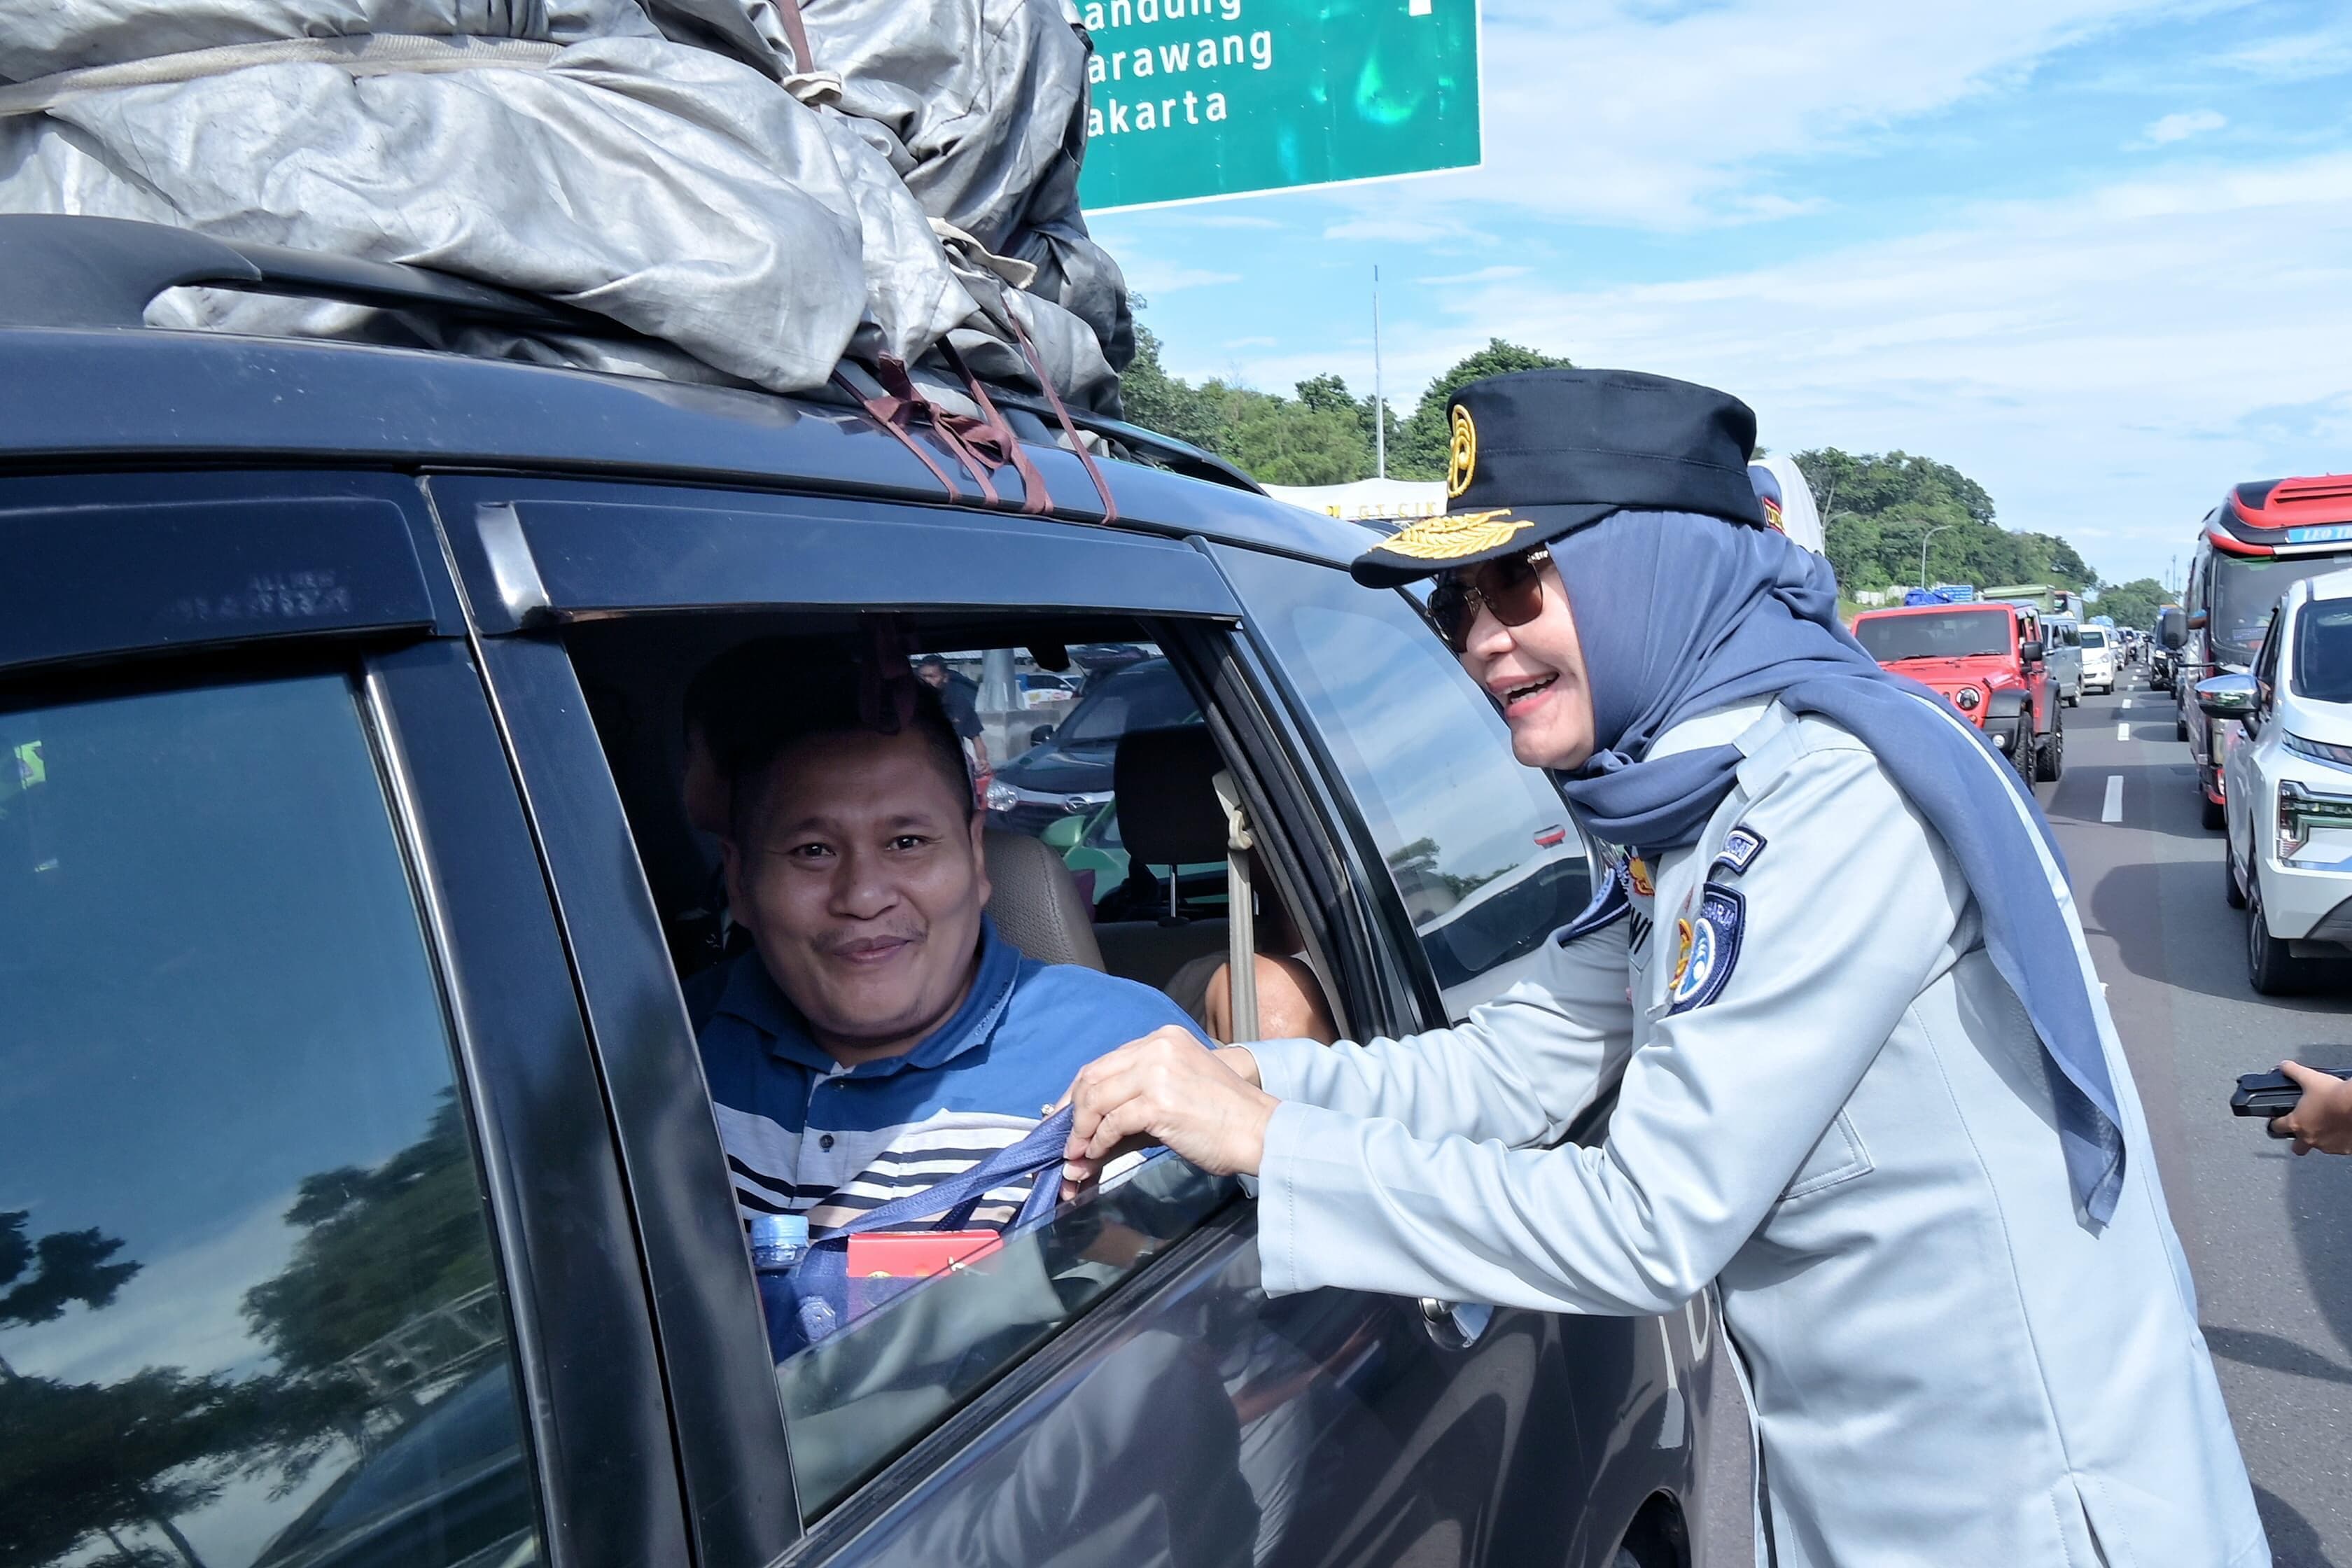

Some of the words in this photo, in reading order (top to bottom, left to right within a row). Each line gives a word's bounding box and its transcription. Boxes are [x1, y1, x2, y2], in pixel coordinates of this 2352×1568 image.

[1086, 0, 1242, 31] andung
[1088, 30, 1273, 84] arawang
[1087, 90, 1227, 137] akarta
